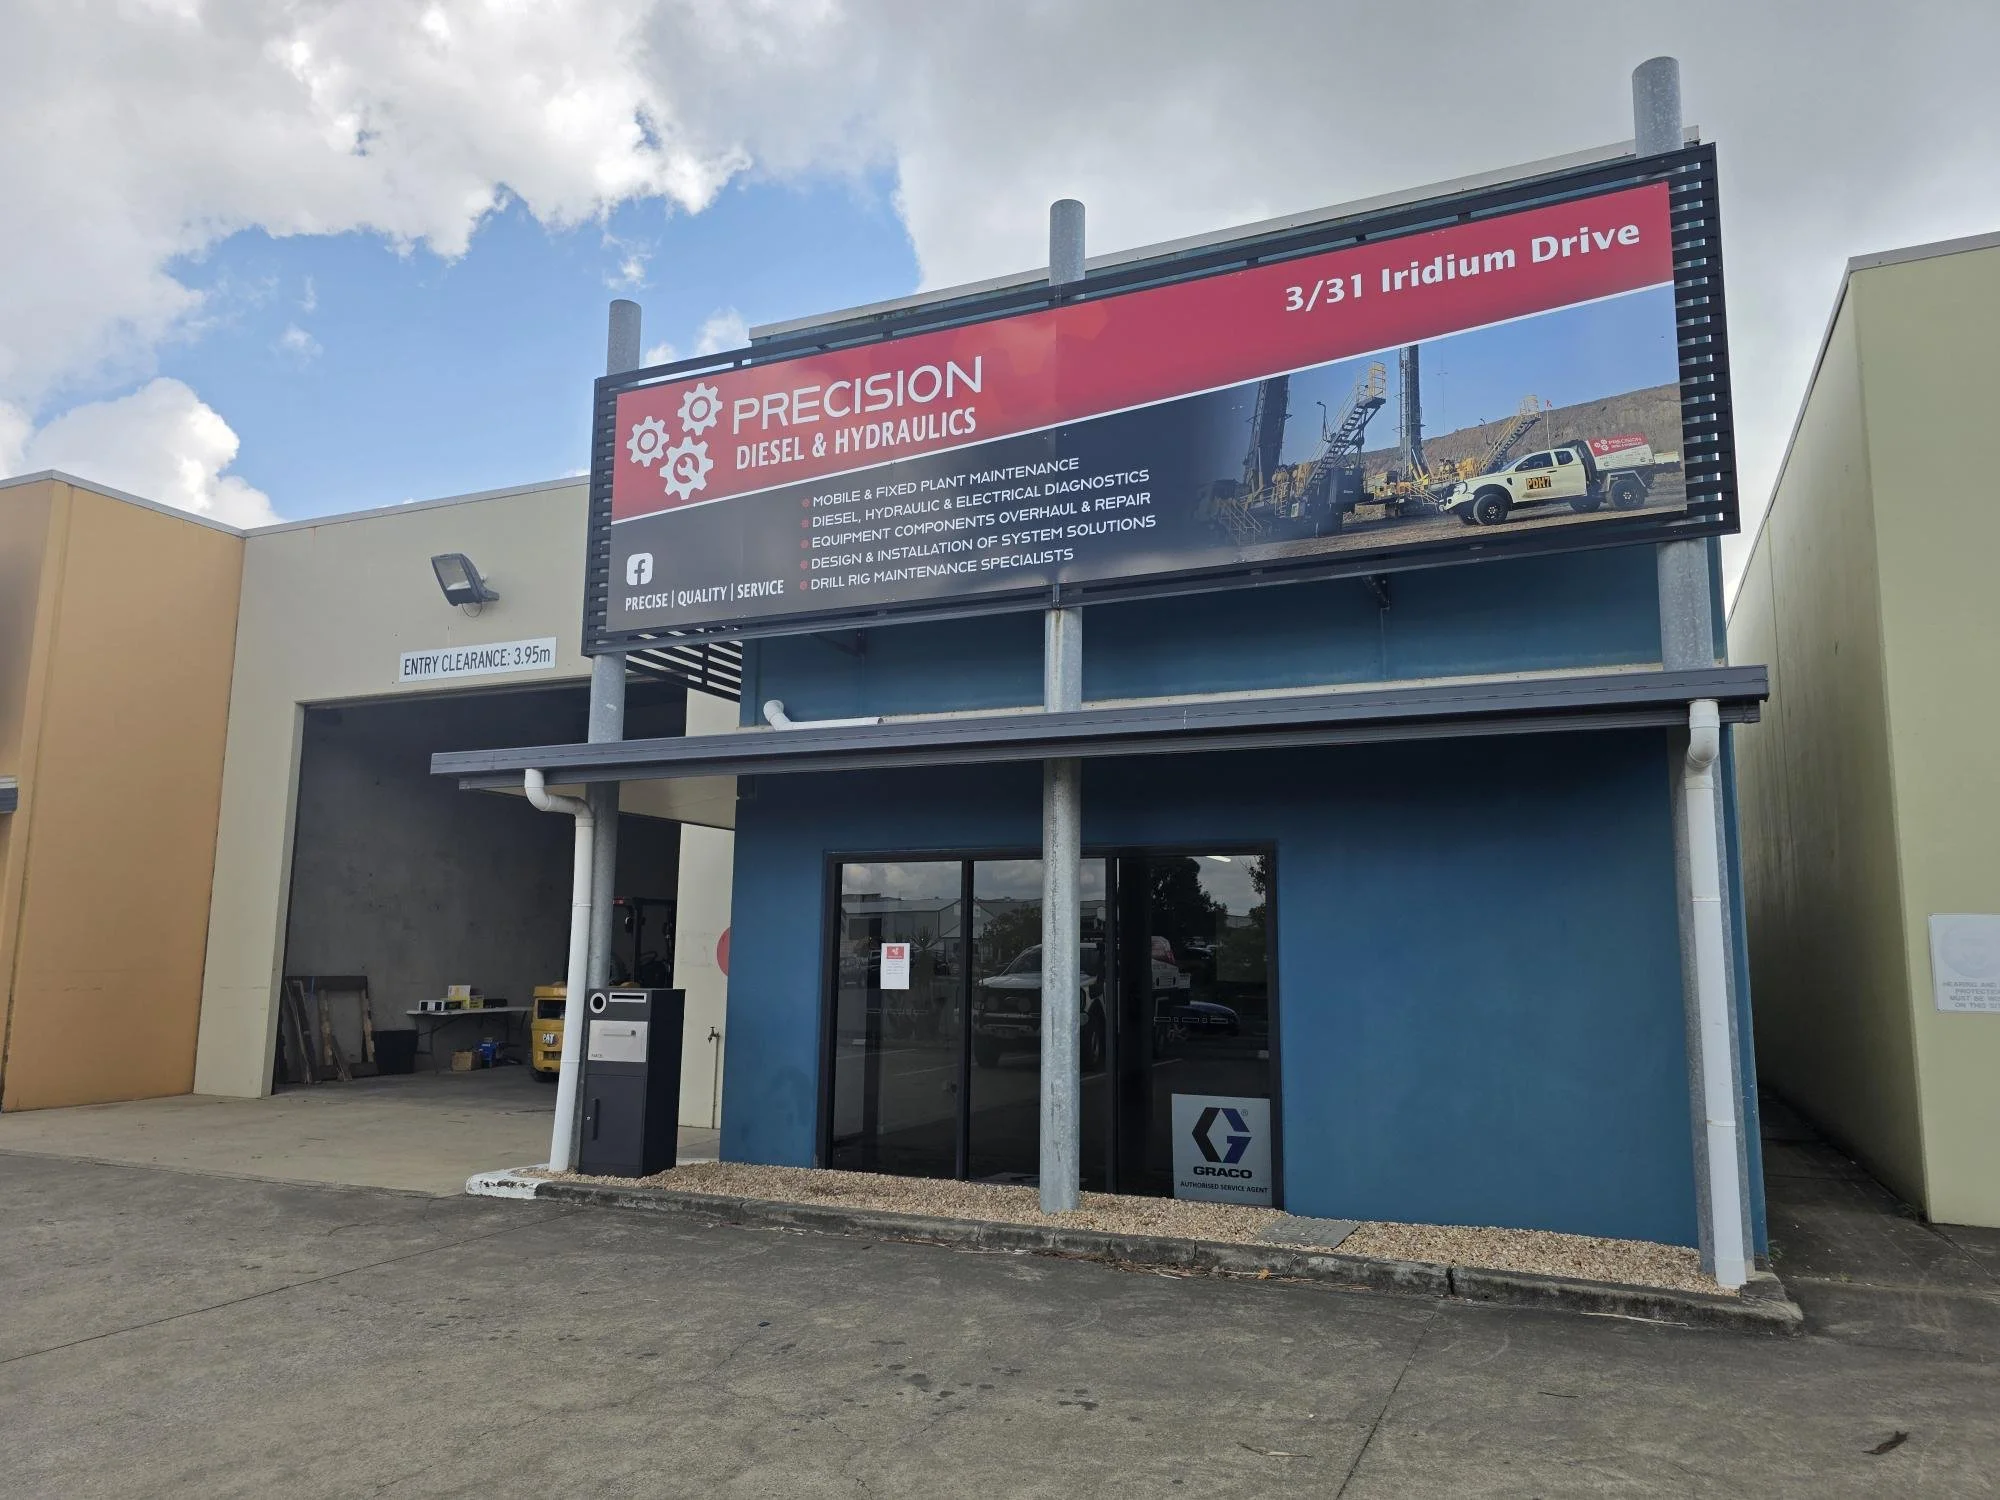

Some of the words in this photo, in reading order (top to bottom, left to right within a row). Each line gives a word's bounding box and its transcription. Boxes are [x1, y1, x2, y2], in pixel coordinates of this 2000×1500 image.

[1285, 273, 1362, 312] 3/31
[1381, 247, 1516, 294] Iridium
[1531, 223, 1640, 264] Drive
[732, 355, 982, 435] PRECISION
[736, 435, 805, 470] DIESEL
[811, 432, 827, 457] &
[835, 407, 977, 454] HYDRAULICS
[812, 511, 861, 529] DIESEL,
[865, 499, 940, 521] HYDRAULIC
[943, 498, 953, 510] &
[956, 485, 1041, 509] ELECTRICAL
[1045, 469, 1150, 496] DIAGNOSTICS
[813, 490, 861, 507] MOBILE
[864, 489, 873, 500] &
[876, 481, 917, 499] FIXED
[920, 474, 966, 492] PLANT
[969, 457, 1080, 485] MAINTENANCE
[811, 552, 862, 570] DESIGN
[865, 551, 874, 563] &
[877, 537, 974, 562] INSTALLATION
[977, 535, 998, 548] OF
[1001, 526, 1063, 546] SYSTEM
[1066, 514, 1156, 538] SOLUTIONS
[812, 527, 891, 549] EQUIPMENT
[894, 513, 995, 537] COMPONENTS
[998, 502, 1077, 524] OVERHAUL
[1081, 500, 1091, 512] &
[1095, 492, 1151, 511] REPAIR
[625, 593, 668, 612] PRECISE
[677, 585, 727, 607] QUALITY
[737, 579, 784, 599] SERVICE
[810, 575, 845, 591] DRILL
[848, 572, 871, 586] RIG
[874, 559, 977, 583] MAINTENANCE
[980, 547, 1074, 571] SPECIALISTS
[404, 655, 439, 676] ENTRY
[441, 648, 511, 672] CLEARANCE:
[513, 645, 550, 665] 3.95m
[1180, 1181, 1219, 1190] AUTHORISED
[1220, 1184, 1245, 1192] SERVICE
[1193, 1166, 1253, 1179] GRACO
